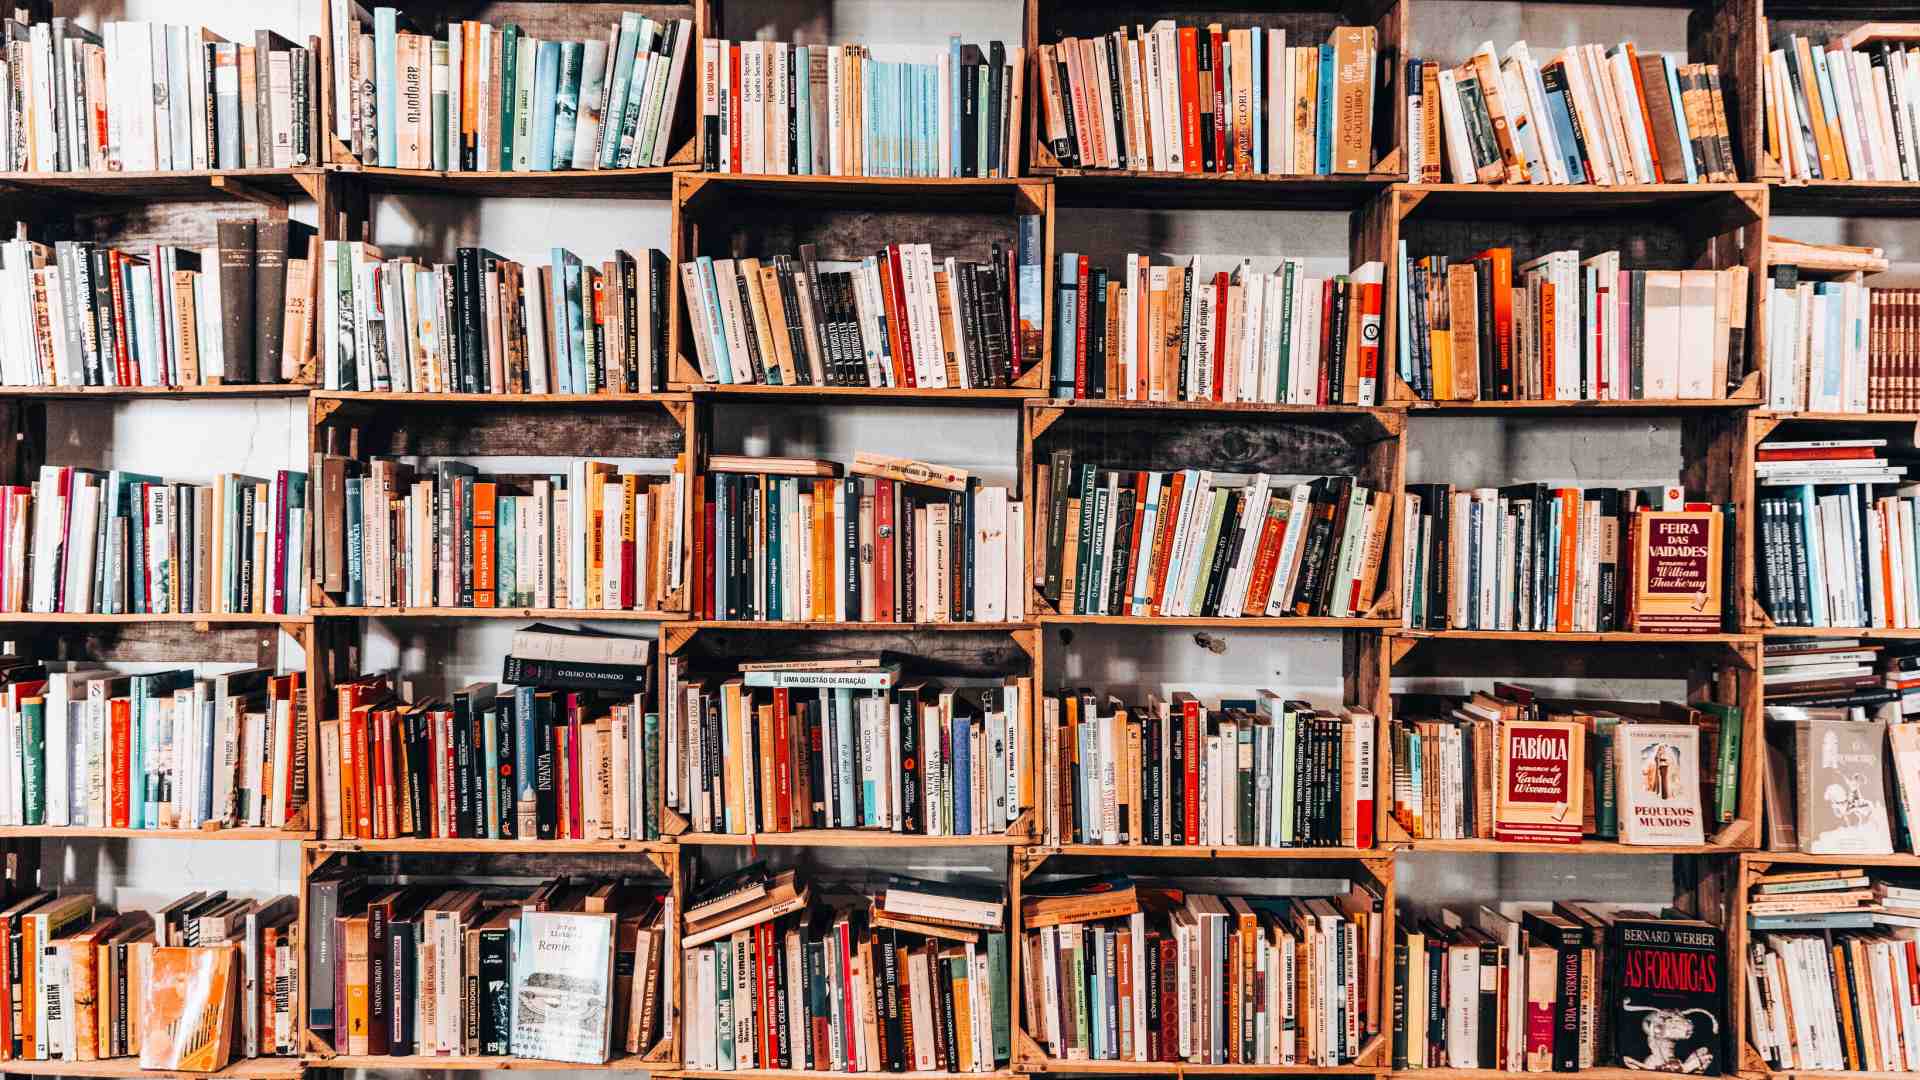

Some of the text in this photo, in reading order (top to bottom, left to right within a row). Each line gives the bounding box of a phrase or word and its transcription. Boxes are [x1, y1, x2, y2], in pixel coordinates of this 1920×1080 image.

[406, 66, 420, 123] aeroporto
[1344, 96, 1352, 131] CAVALO
[1660, 523, 1699, 534] FEIRA
[1668, 536, 1688, 544] DAS
[1648, 546, 1707, 557] VAIDADES
[1657, 566, 1699, 577] William
[1650, 577, 1706, 591] Thackeray
[565, 670, 584, 678] OLHO
[586, 671, 597, 679] DO
[597, 672, 624, 681] MUNDO
[783, 675, 866, 687] UMA QUESTÃO DE ATRAÇÃO
[294, 712, 307, 789] TEIA ENVOLVENTE
[1512, 734, 1568, 761] FABÍOLA
[539, 753, 551, 790] INFANTA
[1515, 772, 1559, 785] Cardeal
[1514, 784, 1562, 795] Wiseman
[1634, 806, 1695, 816] PEQUENOS
[1639, 817, 1692, 827] MUNDOS
[1624, 929, 1716, 946] BERNARD WERBER
[737, 942, 746, 982] romana
[1566, 954, 1577, 995] FORMIGAS
[1623, 950, 1717, 993] AS FORMIGAS
[48, 984, 60, 1020] PERAHIM
[275, 976, 289, 1013] PERAHIM
[1394, 985, 1403, 1032] LAMIA
[1564, 1008, 1577, 1021] DIA
